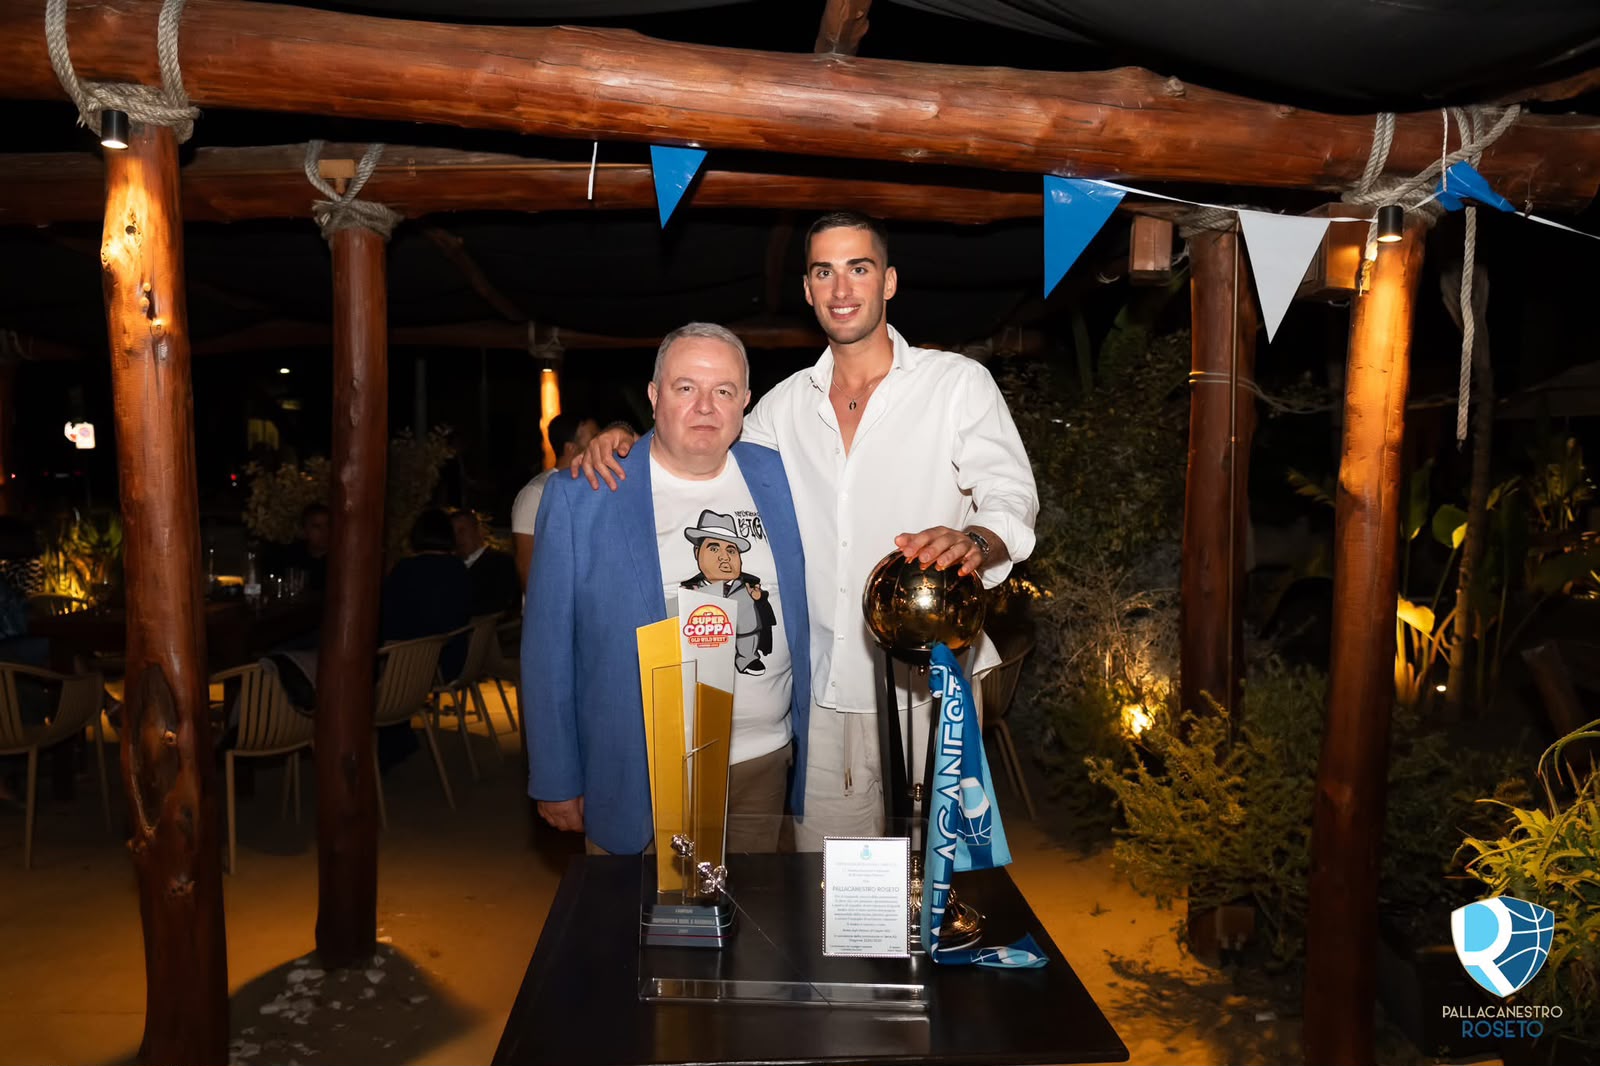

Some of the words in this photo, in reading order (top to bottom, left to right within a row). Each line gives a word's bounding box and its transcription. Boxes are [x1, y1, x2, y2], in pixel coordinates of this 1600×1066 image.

[691, 616, 725, 625] SUPER
[684, 623, 732, 636] COPPA
[832, 885, 877, 893] PALLACANESTRO
